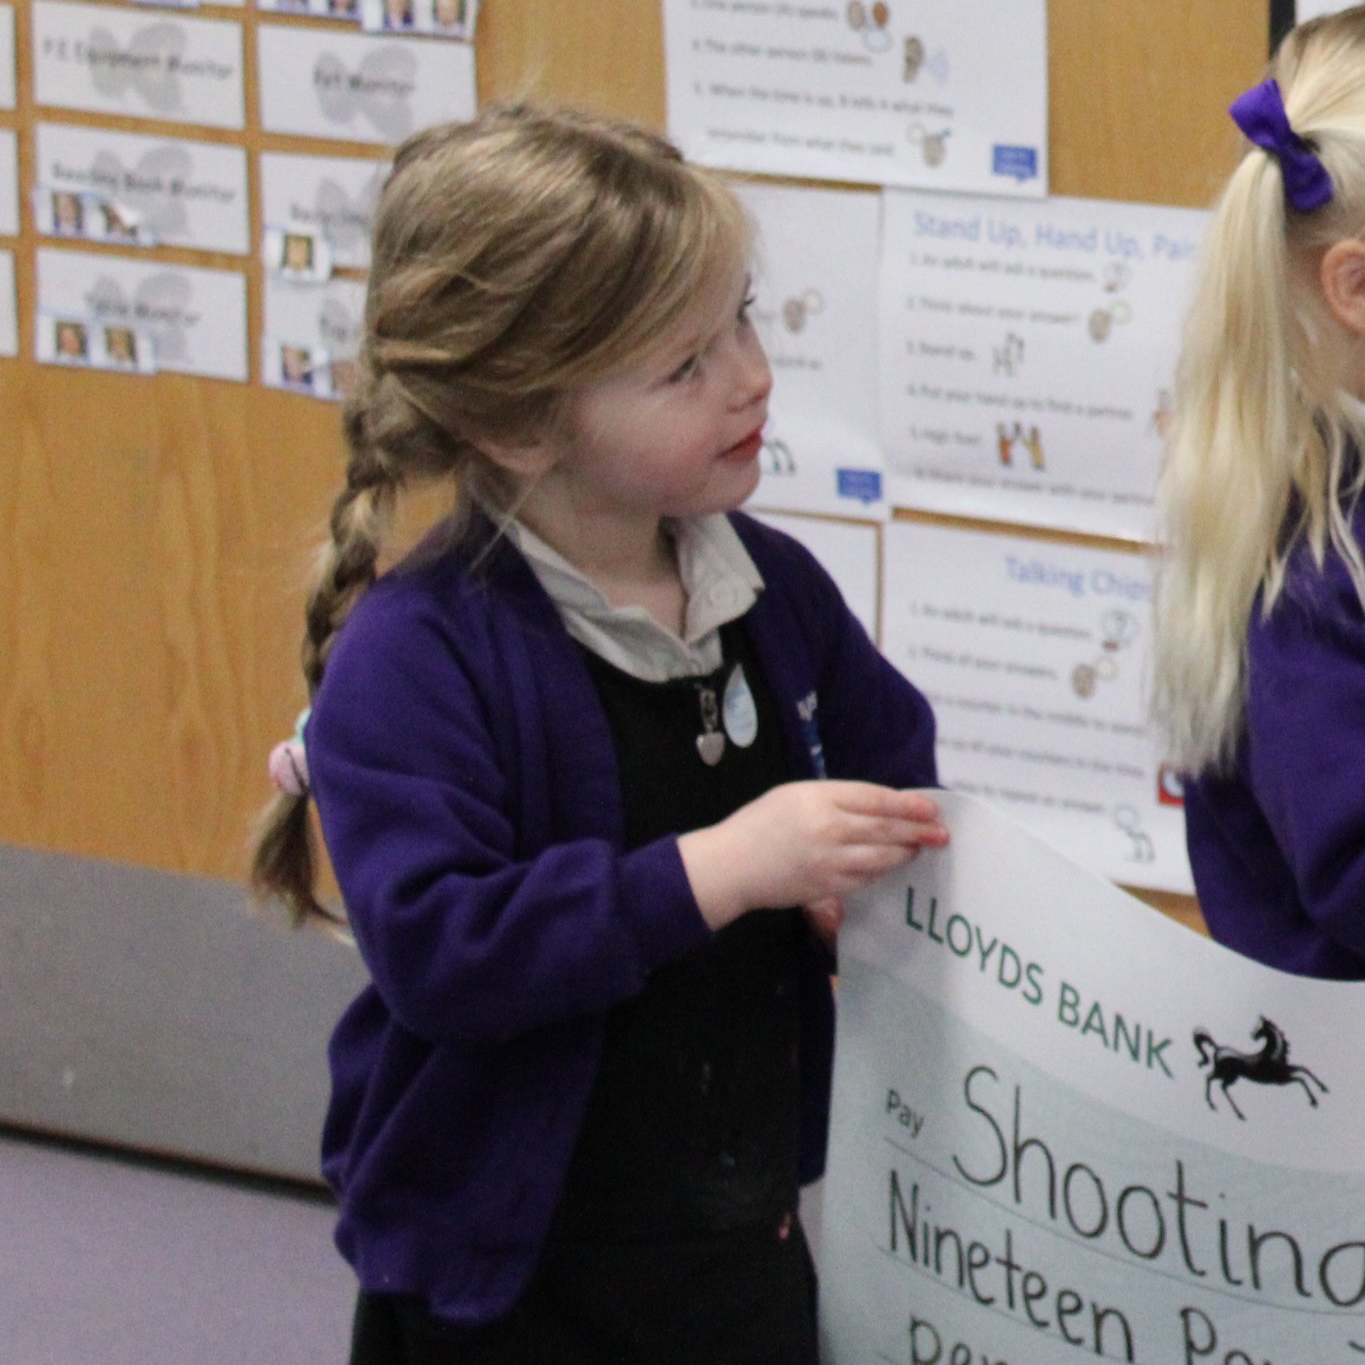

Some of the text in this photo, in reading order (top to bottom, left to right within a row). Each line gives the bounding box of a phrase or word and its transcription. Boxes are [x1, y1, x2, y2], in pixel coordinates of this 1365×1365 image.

[914, 211, 979, 242] Stand
[988, 218, 1028, 248] Up,
[1036, 224, 1097, 252] Hand
[1006, 553, 1085, 595] Talking
[905, 886, 1175, 1080] LLOYDS BANK
[886, 1088, 925, 1139] Pay
[891, 1169, 1135, 1363] Nineteen
